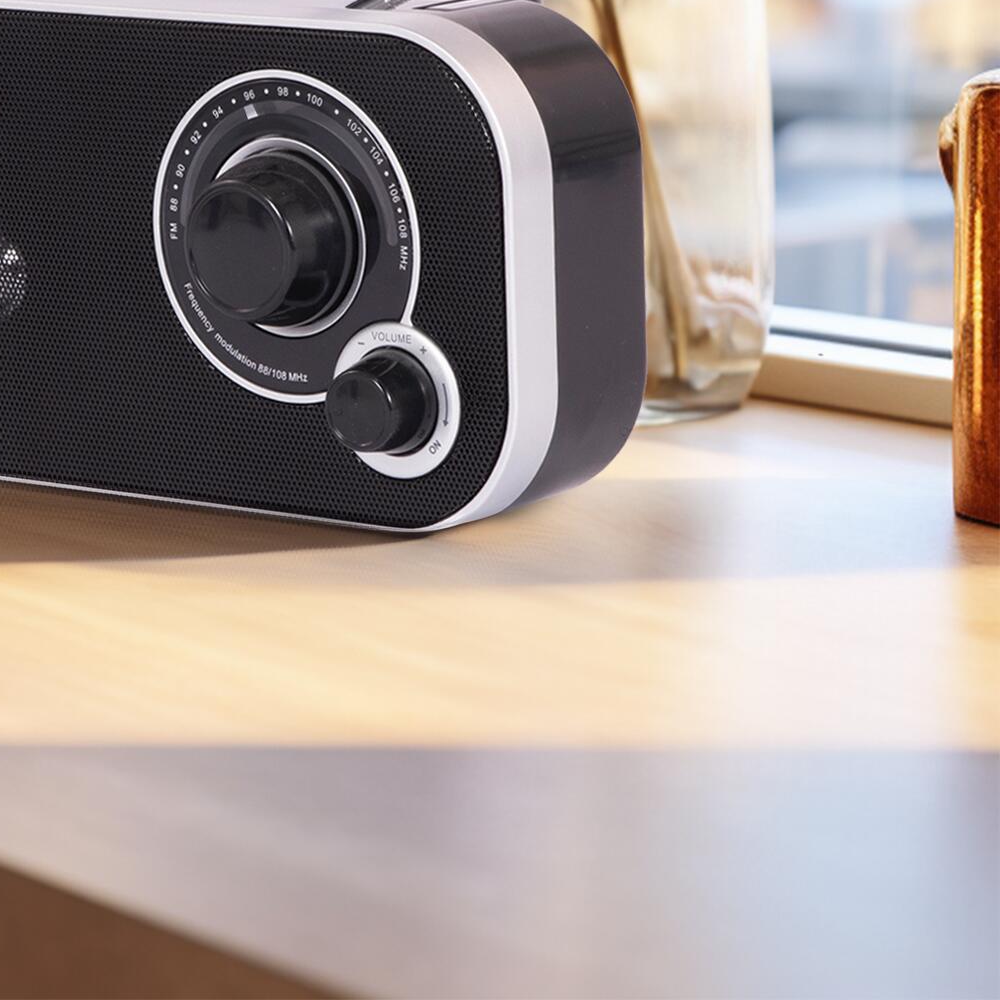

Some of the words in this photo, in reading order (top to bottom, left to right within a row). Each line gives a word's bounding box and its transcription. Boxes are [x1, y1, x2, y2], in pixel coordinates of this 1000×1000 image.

[243, 90, 255, 100] 96
[277, 86, 289, 97] 98
[306, 93, 323, 107] 100
[212, 106, 224, 119] 94
[347, 118, 362, 136] 102
[190, 130, 202, 145] 92
[369, 146, 383, 165] 104
[176, 164, 185, 178] 90
[388, 183, 400, 204] 106
[170, 197, 178, 212] 88
[170, 222, 178, 239] FM
[397, 219, 407, 238] 108
[399, 245, 409, 270] MHz
[184, 283, 214, 332] Frequency
[215, 333, 257, 371] modulation
[257, 363, 288, 381] 88/108
[288, 372, 308, 383] MHz
[371, 331, 412, 344] VOLUME
[429, 440, 442, 455] ON
